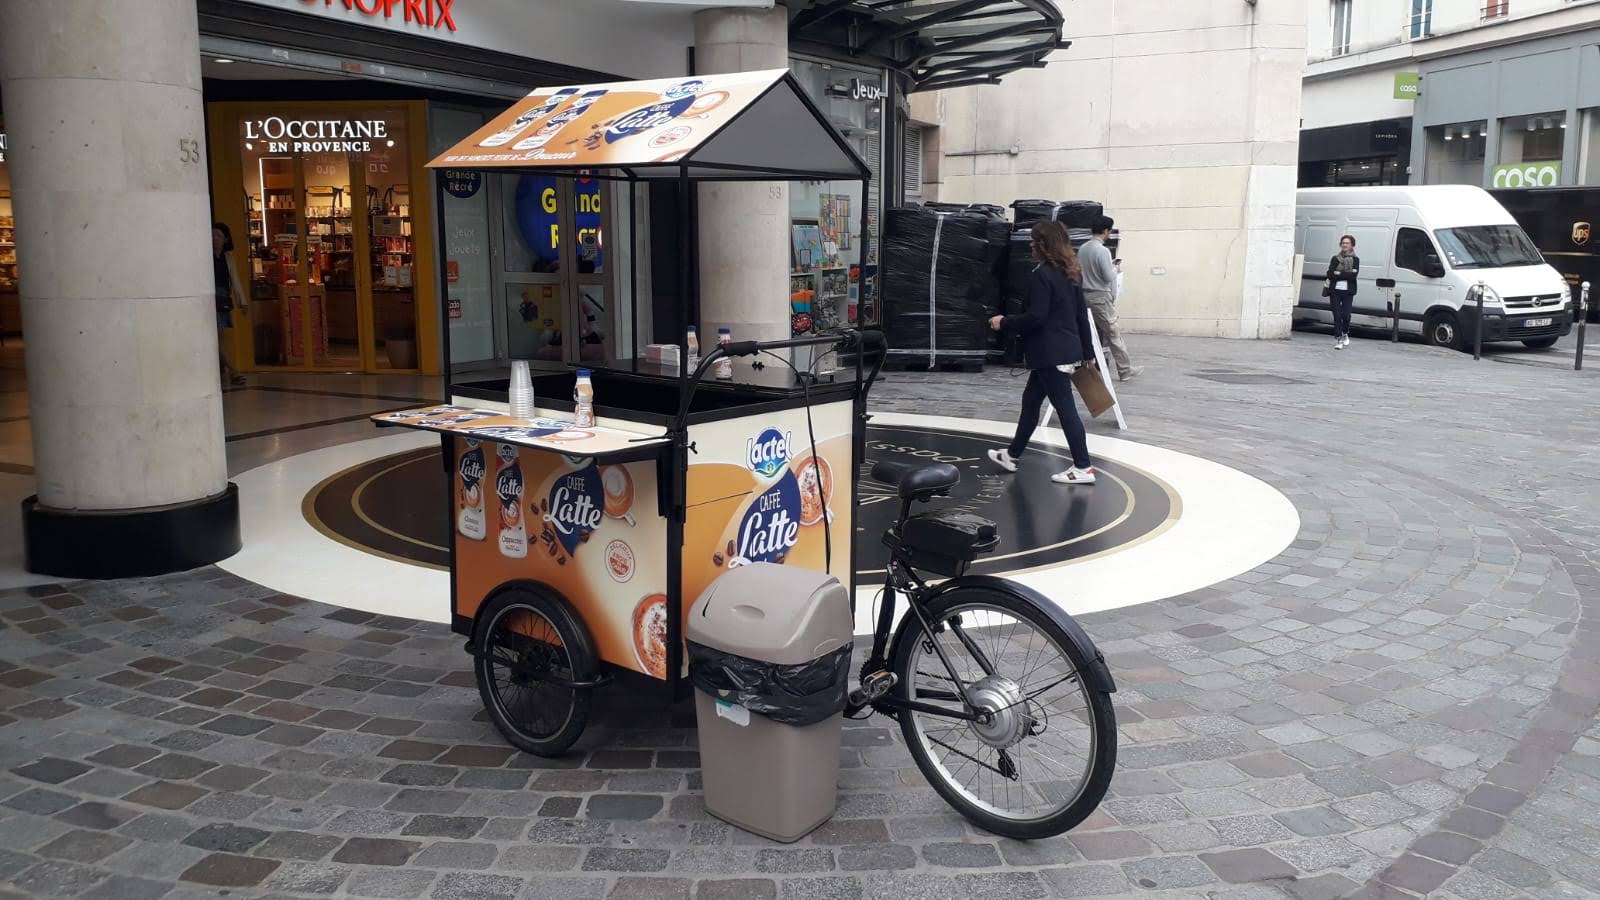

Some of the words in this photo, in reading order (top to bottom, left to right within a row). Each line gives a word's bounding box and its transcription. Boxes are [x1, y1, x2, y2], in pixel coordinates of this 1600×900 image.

[852, 77, 881, 101] Jeux
[180, 139, 201, 166] 53
[268, 141, 289, 153] EN
[294, 141, 371, 153] PROVENCE
[769, 186, 782, 200] 53
[745, 430, 793, 472] lactel
[458, 457, 485, 482] Latte
[496, 475, 523, 501] Latte
[759, 489, 781, 512] CAFFÈ
[543, 486, 602, 535] Latte
[728, 508, 799, 569] Latte
